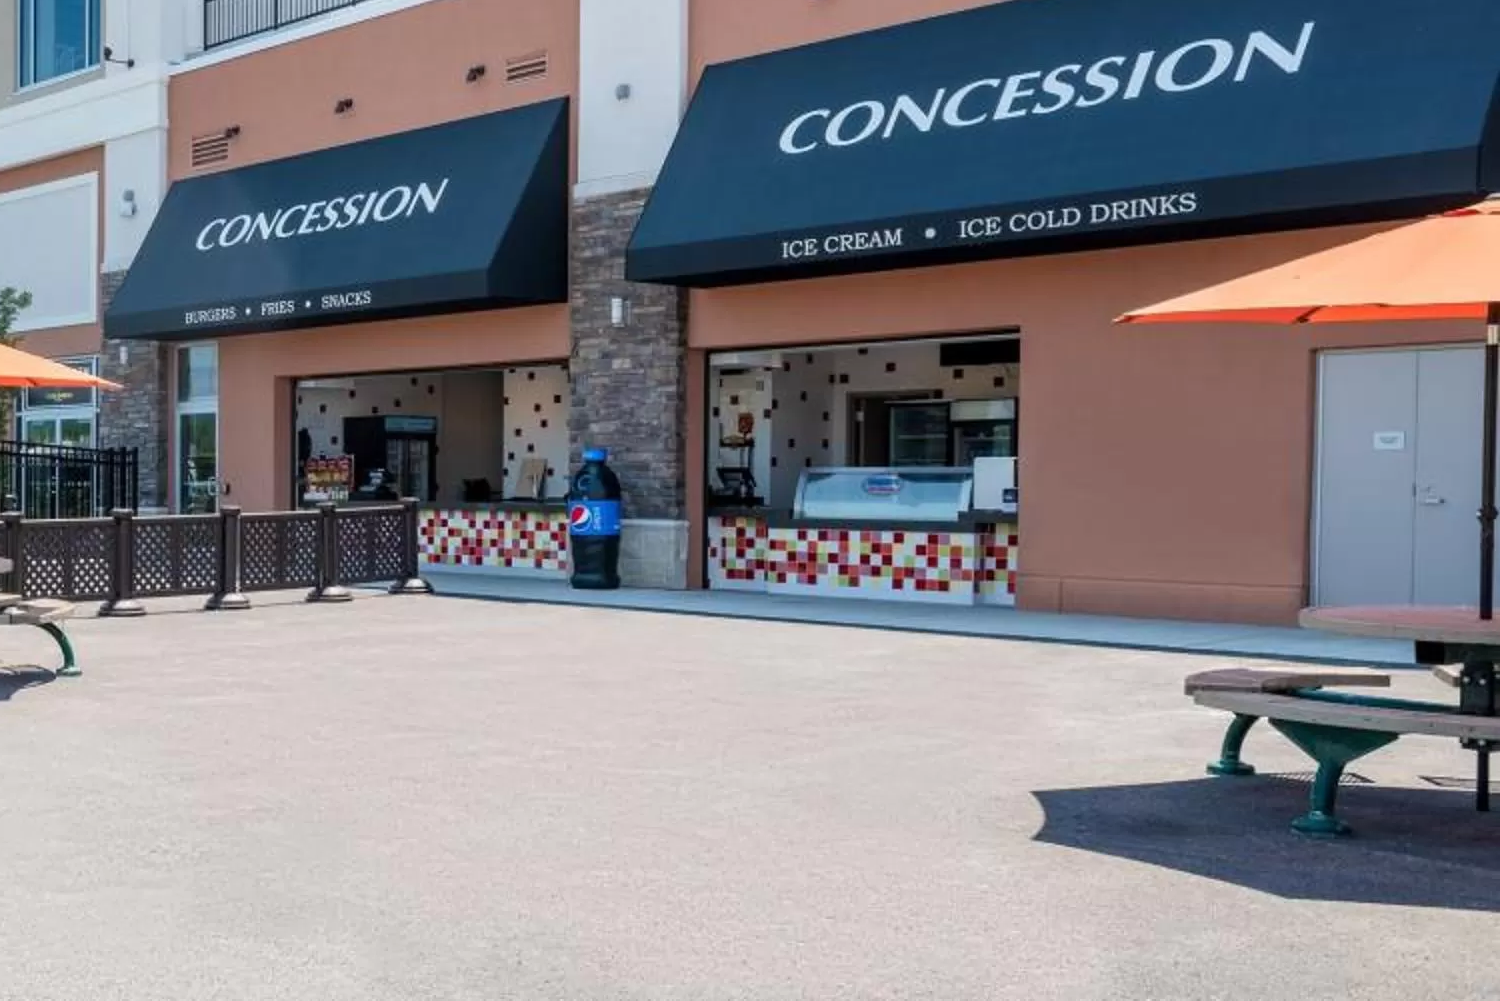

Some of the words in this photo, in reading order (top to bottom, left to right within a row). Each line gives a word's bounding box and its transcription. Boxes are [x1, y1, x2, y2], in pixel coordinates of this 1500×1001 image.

[778, 20, 1317, 155] CONCESSION
[195, 178, 449, 252] CONCESSION
[782, 239, 818, 259] ICE
[823, 228, 903, 254] CREAM
[959, 216, 1001, 239] ICE
[1009, 207, 1082, 233] COLD
[1090, 192, 1197, 225] DRINKS
[185, 306, 237, 325] BURGERS
[261, 300, 295, 317] FRIES
[321, 290, 373, 310] SNACKS
